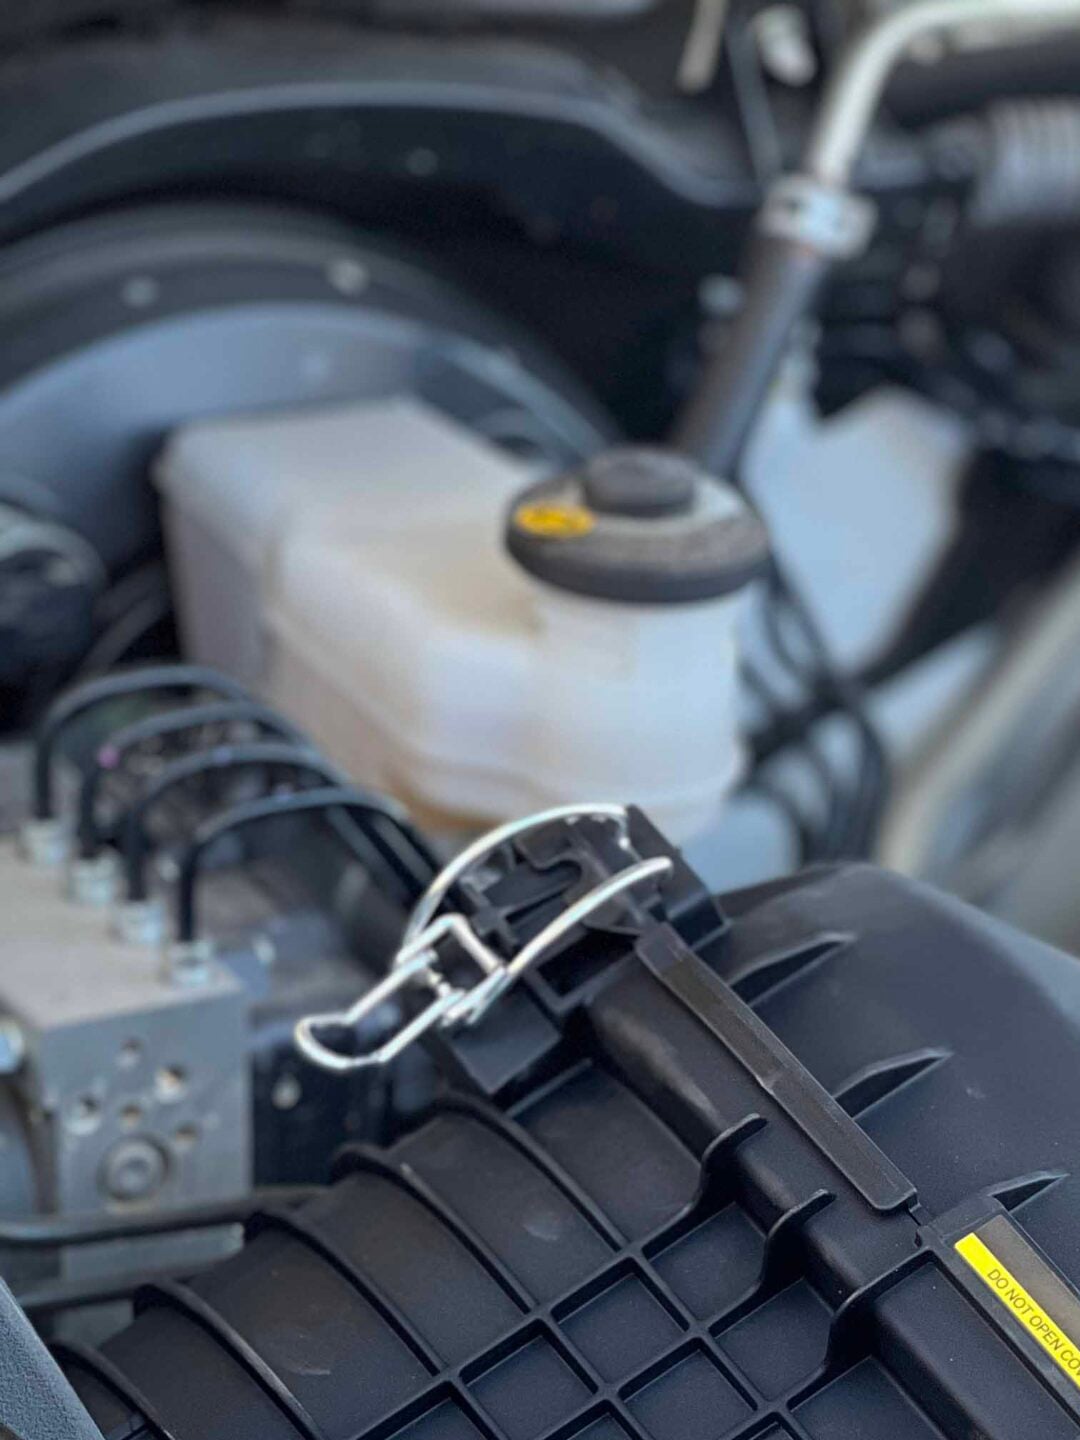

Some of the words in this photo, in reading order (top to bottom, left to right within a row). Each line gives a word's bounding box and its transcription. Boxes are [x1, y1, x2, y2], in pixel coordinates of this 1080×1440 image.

[986, 1268, 1010, 1290] DO
[1004, 1288, 1035, 1315] NOT
[1028, 1314, 1065, 1351] OPEN
